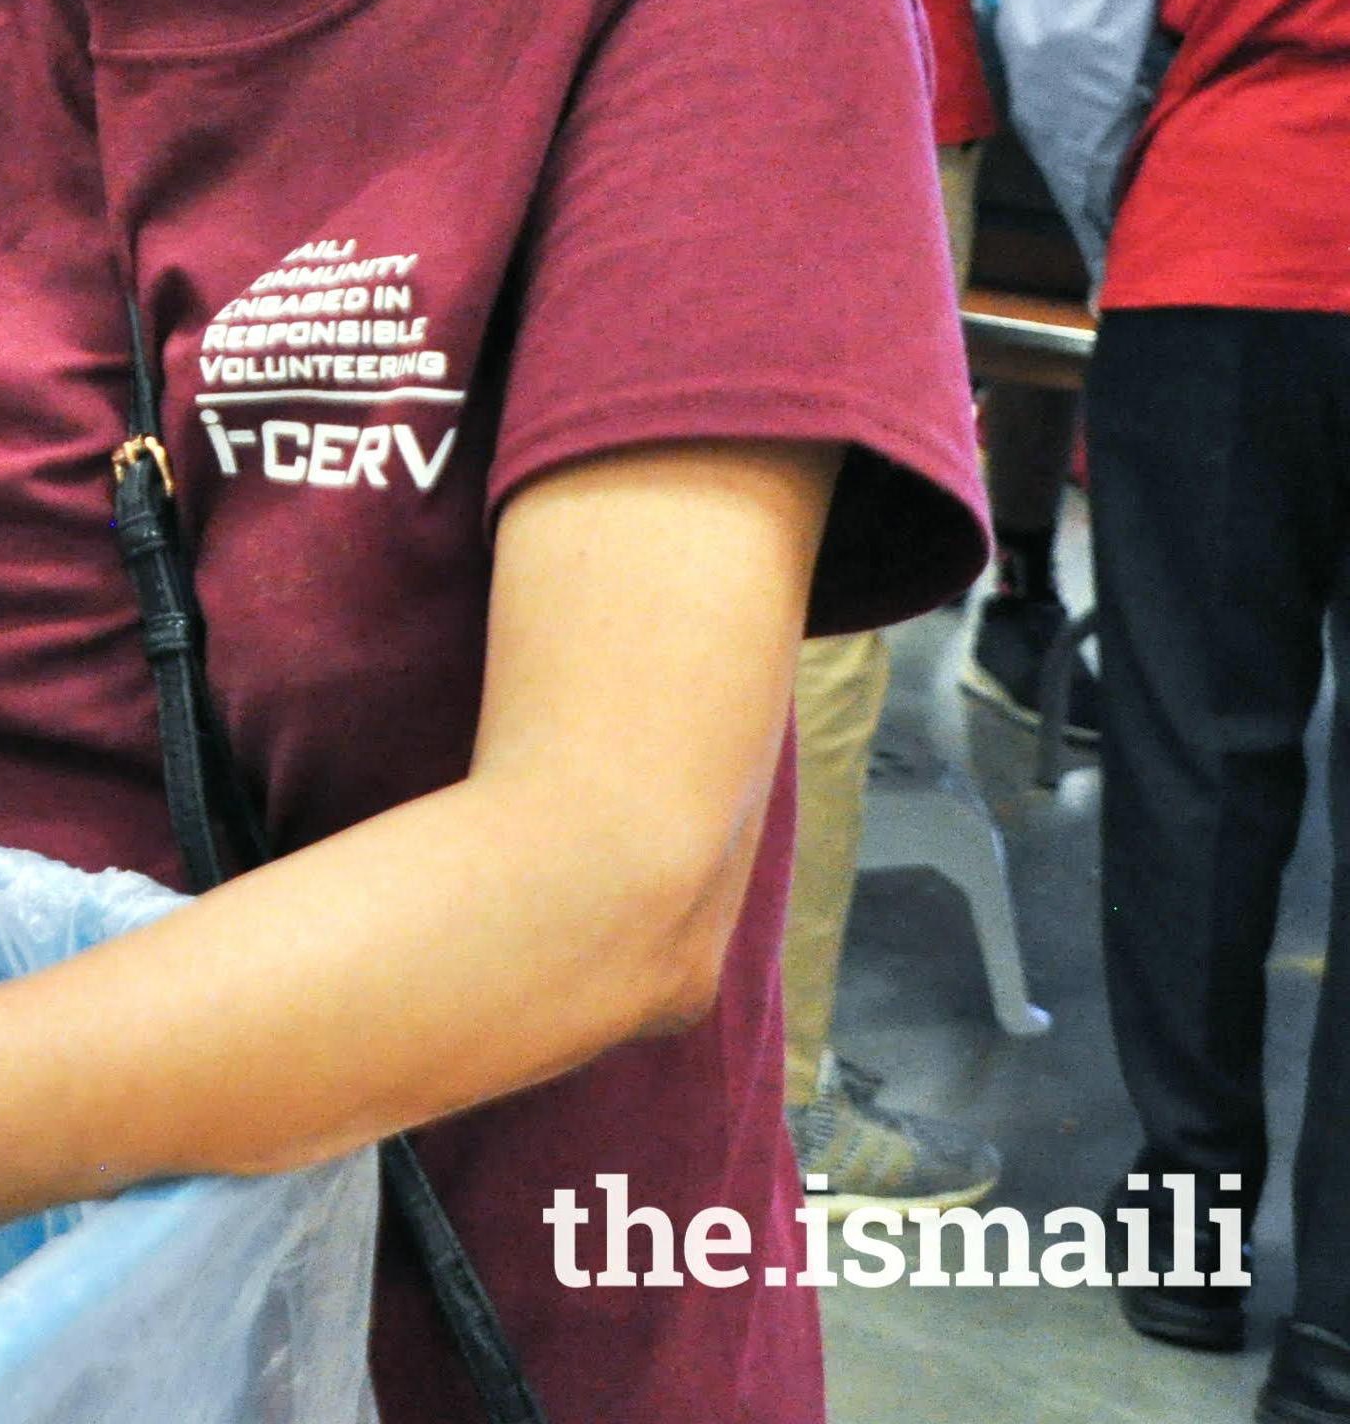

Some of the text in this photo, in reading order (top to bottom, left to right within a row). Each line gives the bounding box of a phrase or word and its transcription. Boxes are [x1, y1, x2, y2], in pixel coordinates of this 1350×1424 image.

[374, 285, 411, 310] IN
[201, 317, 428, 351] RESPONSIBLE
[199, 351, 447, 384] VOLUNTEERING
[200, 409, 457, 489] i-CERV
